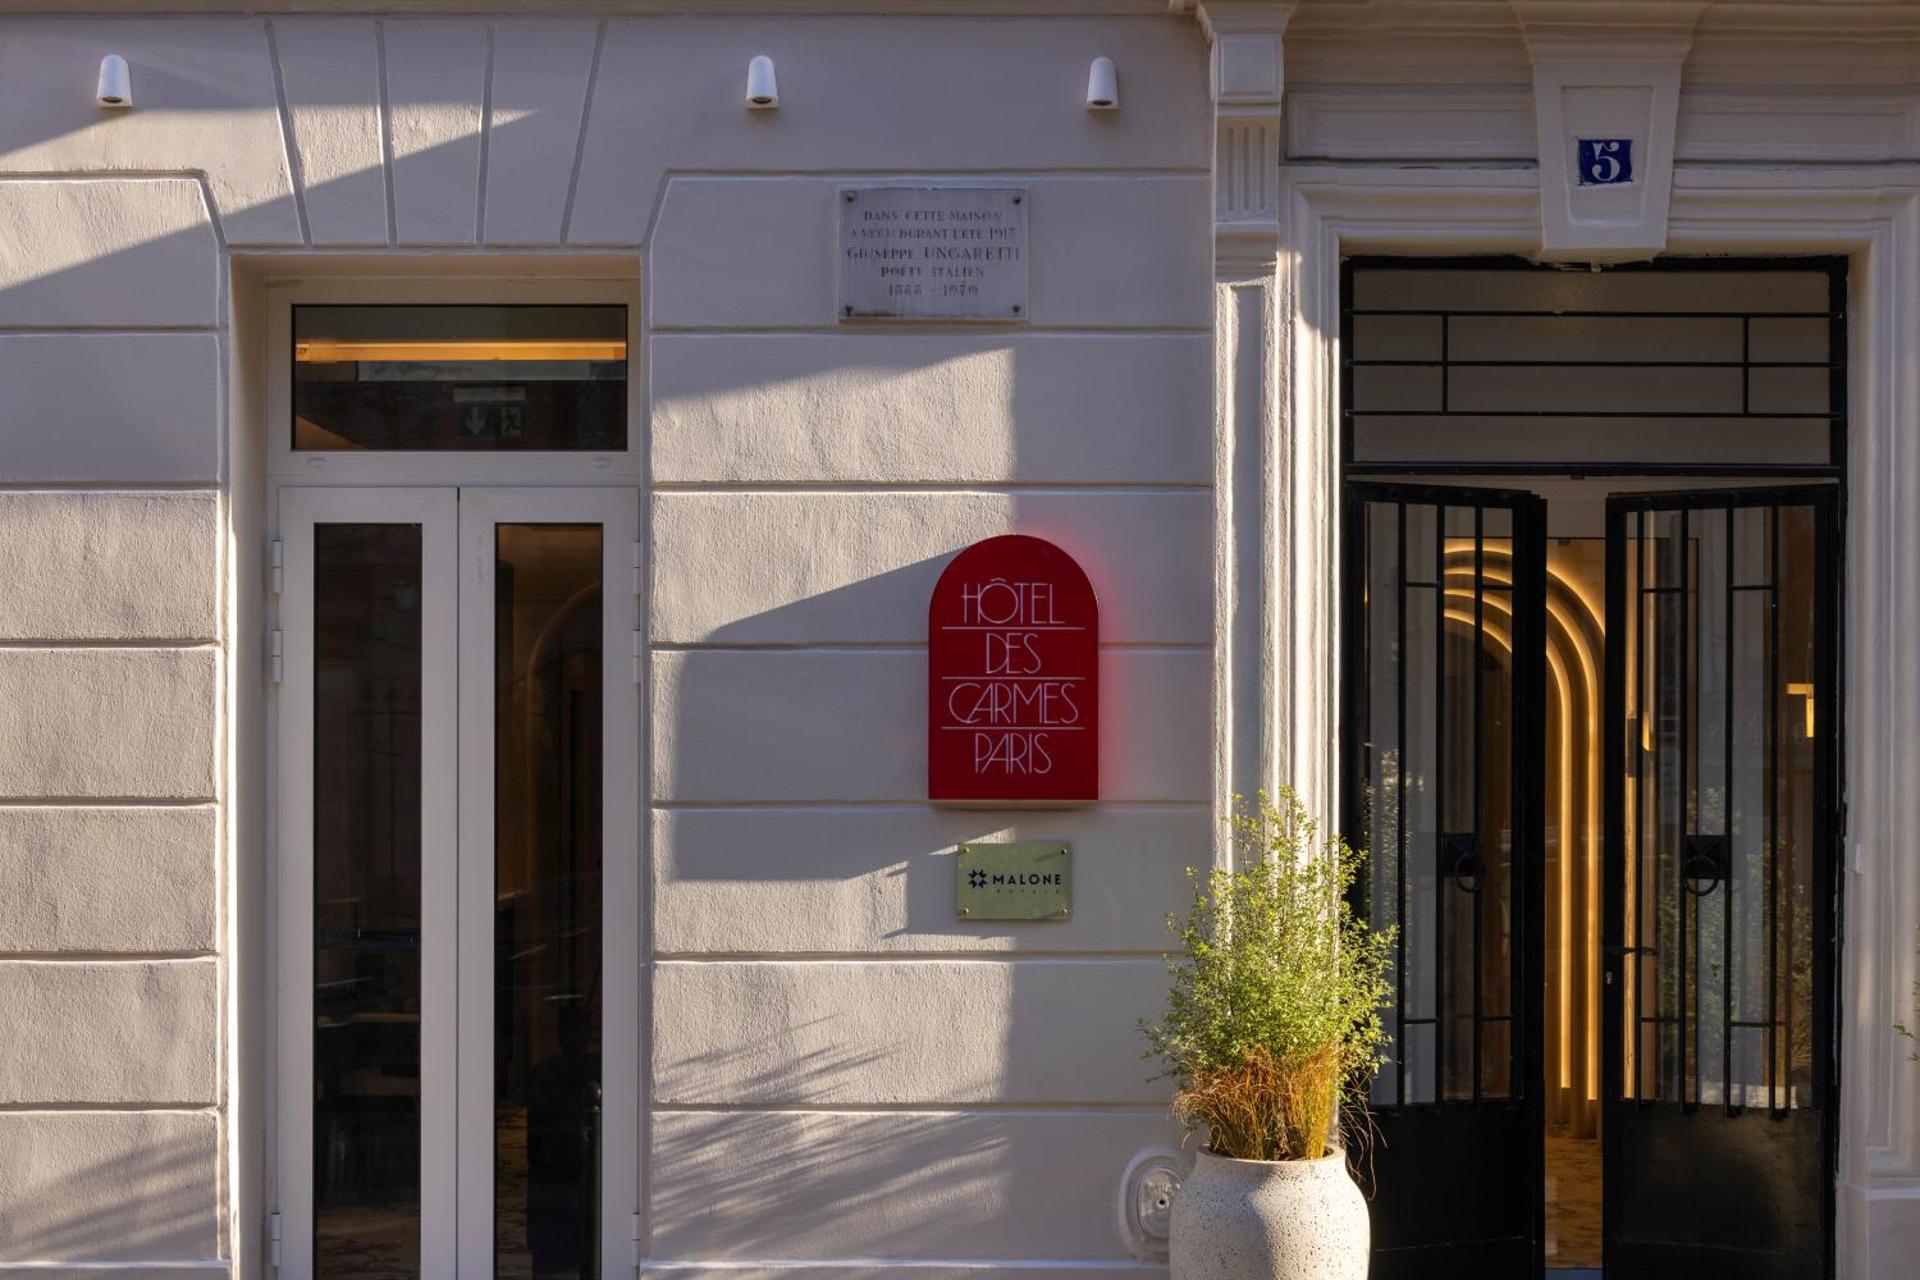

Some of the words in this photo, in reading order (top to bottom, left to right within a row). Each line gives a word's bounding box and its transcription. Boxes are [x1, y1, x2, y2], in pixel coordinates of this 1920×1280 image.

[1591, 141, 1621, 181] 5
[863, 210, 899, 221] DANS
[904, 210, 945, 221] CETTE
[949, 210, 1003, 221] MAISON
[898, 228, 948, 240] DURANT
[846, 247, 914, 260] GIUSEPPE
[923, 246, 1020, 261] UNGARETTI
[931, 266, 984, 278] ITALIEN
[962, 577, 1065, 625] HÔTEL
[985, 632, 1042, 675] DES
[949, 682, 1079, 725] CARMES
[975, 732, 1053, 775] PARIS
[992, 873, 1062, 886] MALONE
